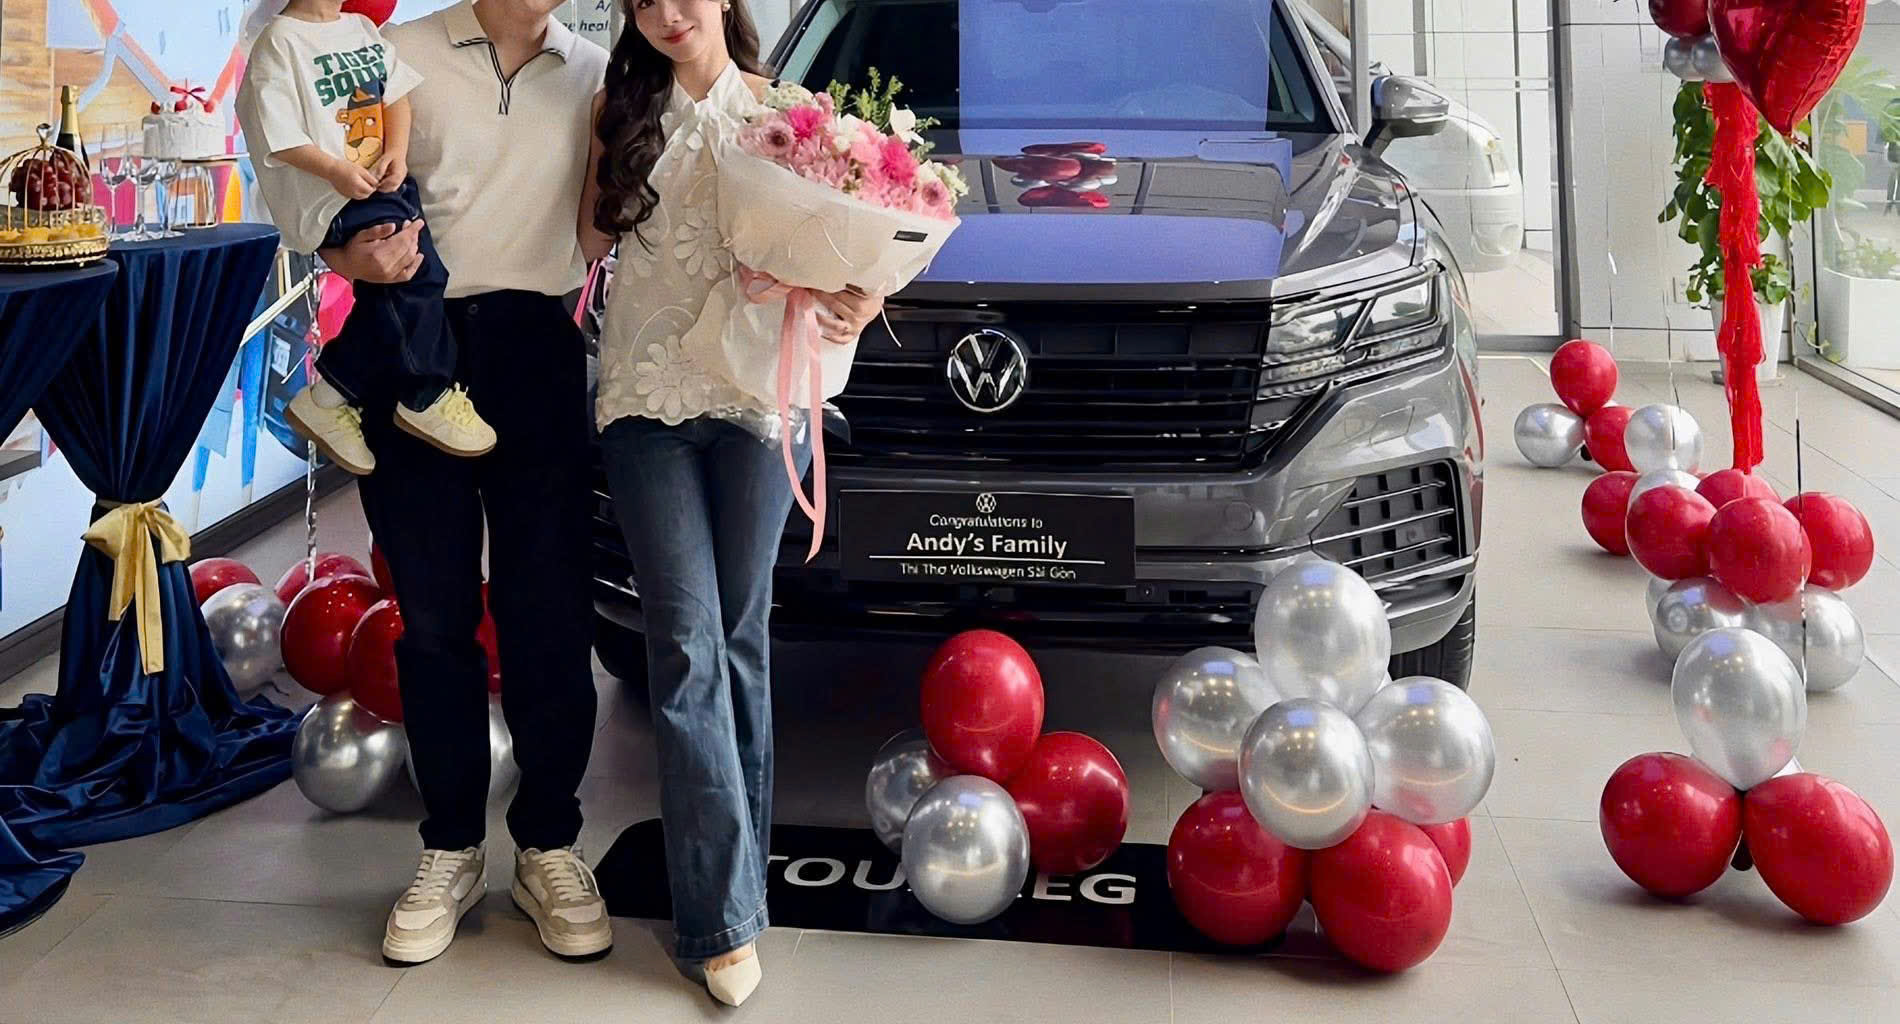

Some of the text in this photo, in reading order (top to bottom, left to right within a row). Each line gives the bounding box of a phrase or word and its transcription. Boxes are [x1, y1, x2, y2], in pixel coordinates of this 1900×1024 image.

[991, 534, 1068, 560] Family
[950, 562, 1025, 580] Volkswagen
[768, 855, 1137, 905] OUEG
